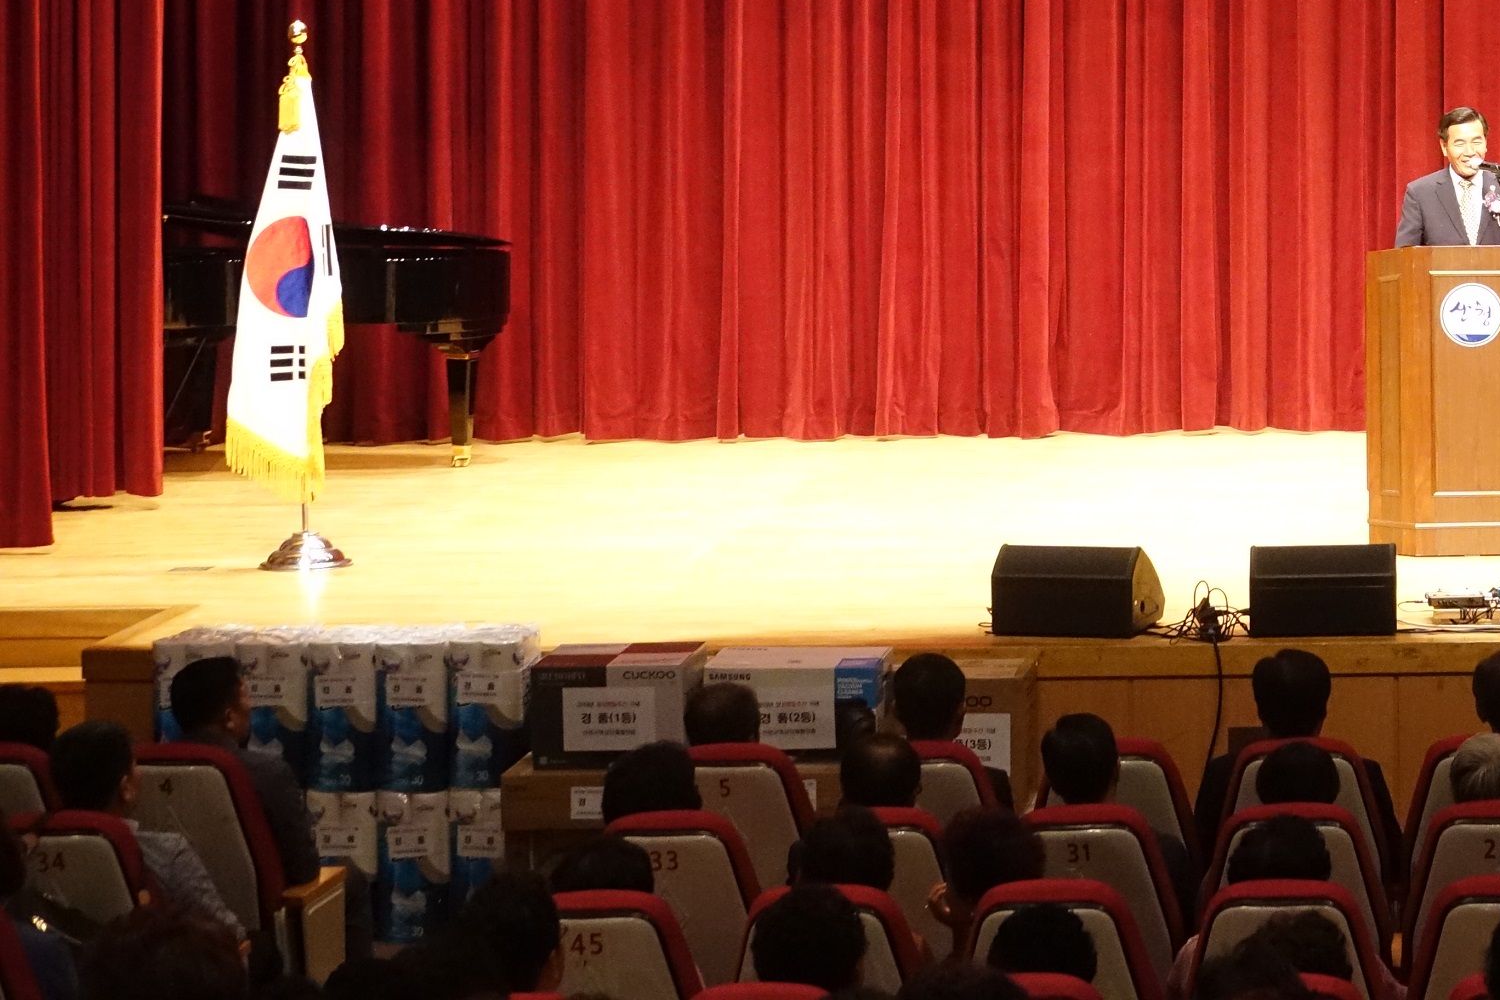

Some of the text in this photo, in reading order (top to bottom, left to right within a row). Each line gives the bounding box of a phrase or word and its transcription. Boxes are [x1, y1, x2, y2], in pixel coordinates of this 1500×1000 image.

[623, 670, 676, 680] CUCKOO
[708, 673, 751, 681] SAMSUNG
[719, 778, 731, 798] 5
[36, 851, 66, 873] 34
[650, 851, 679, 871] 33
[1067, 843, 1091, 863] 31
[571, 932, 604, 956] 45
